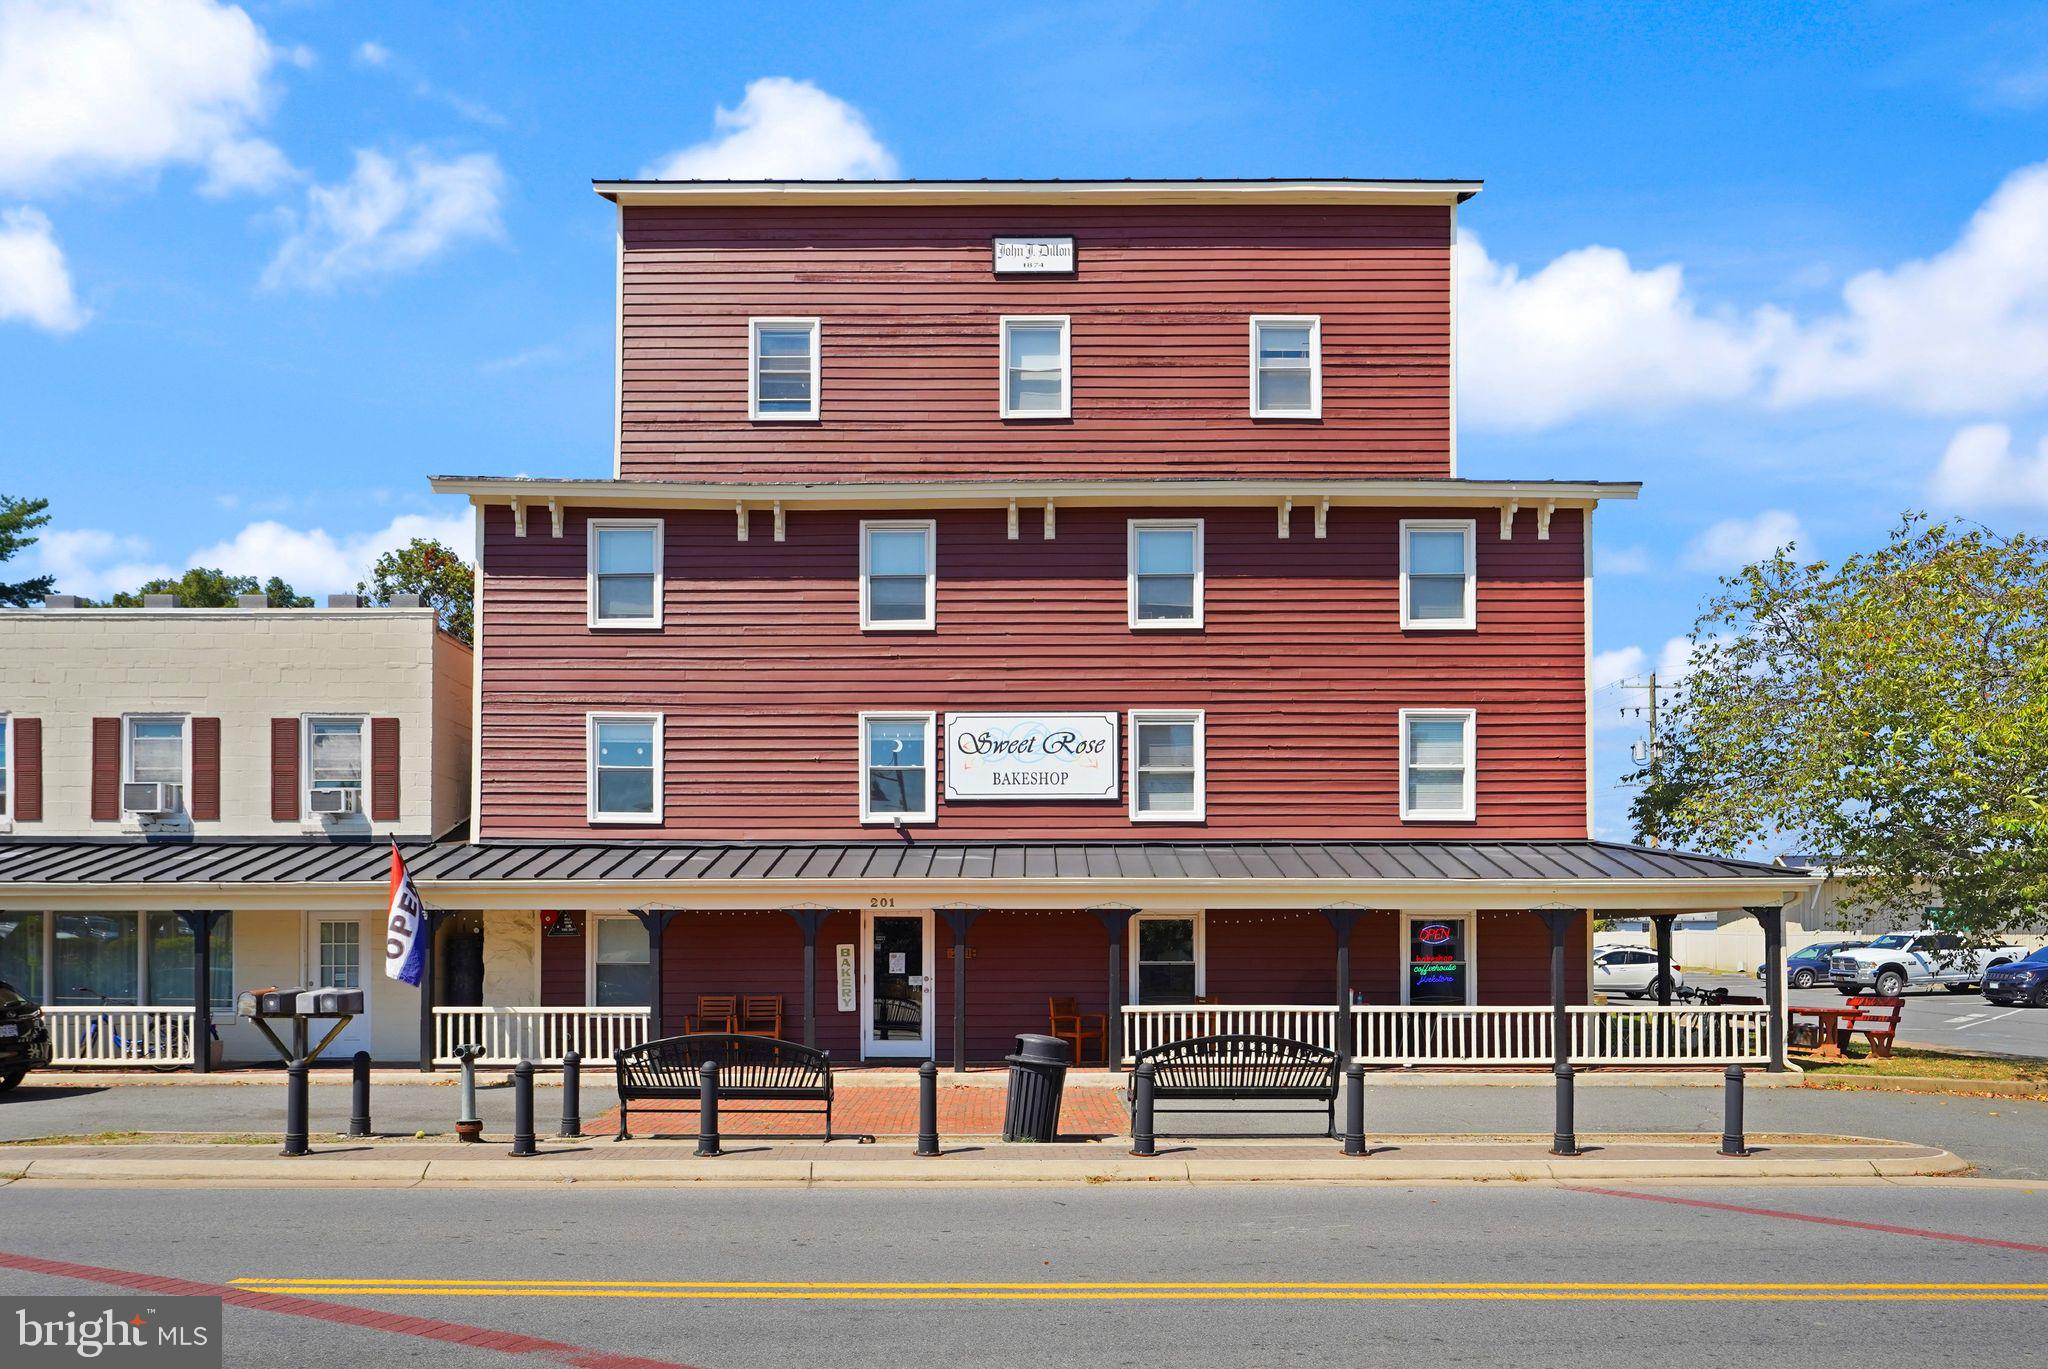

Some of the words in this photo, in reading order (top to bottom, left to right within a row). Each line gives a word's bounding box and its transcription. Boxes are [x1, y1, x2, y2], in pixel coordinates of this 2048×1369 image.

[997, 243, 1024, 259] John
[1038, 243, 1071, 257] Dillon
[958, 731, 1037, 755] Sweet
[1042, 731, 1106, 755] Rose
[993, 772, 1069, 785] BAKESHOP
[870, 897, 895, 908] 201
[1419, 927, 1450, 941] OPEN
[1413, 963, 1457, 976] coffeehouse
[840, 948, 852, 1008] BAKERY
